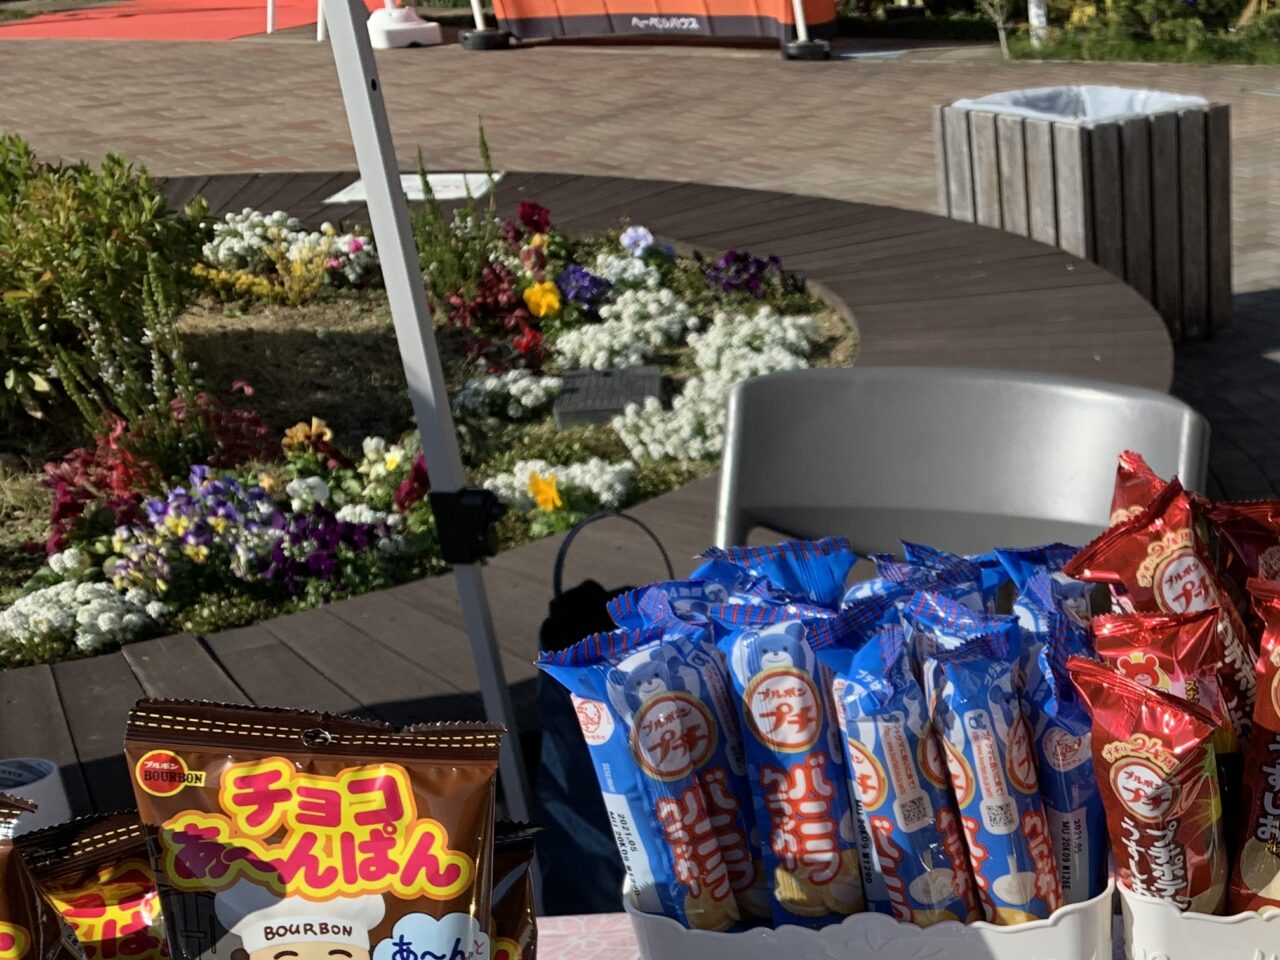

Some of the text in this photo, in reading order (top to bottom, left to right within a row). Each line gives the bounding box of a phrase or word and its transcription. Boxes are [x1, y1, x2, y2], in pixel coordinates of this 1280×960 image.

[757, 687, 808, 701] ブルボン
[759, 702, 817, 734] プチ
[647, 724, 707, 768] プチ
[143, 760, 180, 770] ブルボン
[143, 769, 204, 786] BOURBON
[1122, 769, 1163, 790] ブルボン
[231, 767, 405, 828] チョコ
[263, 922, 354, 940] BOURBON
